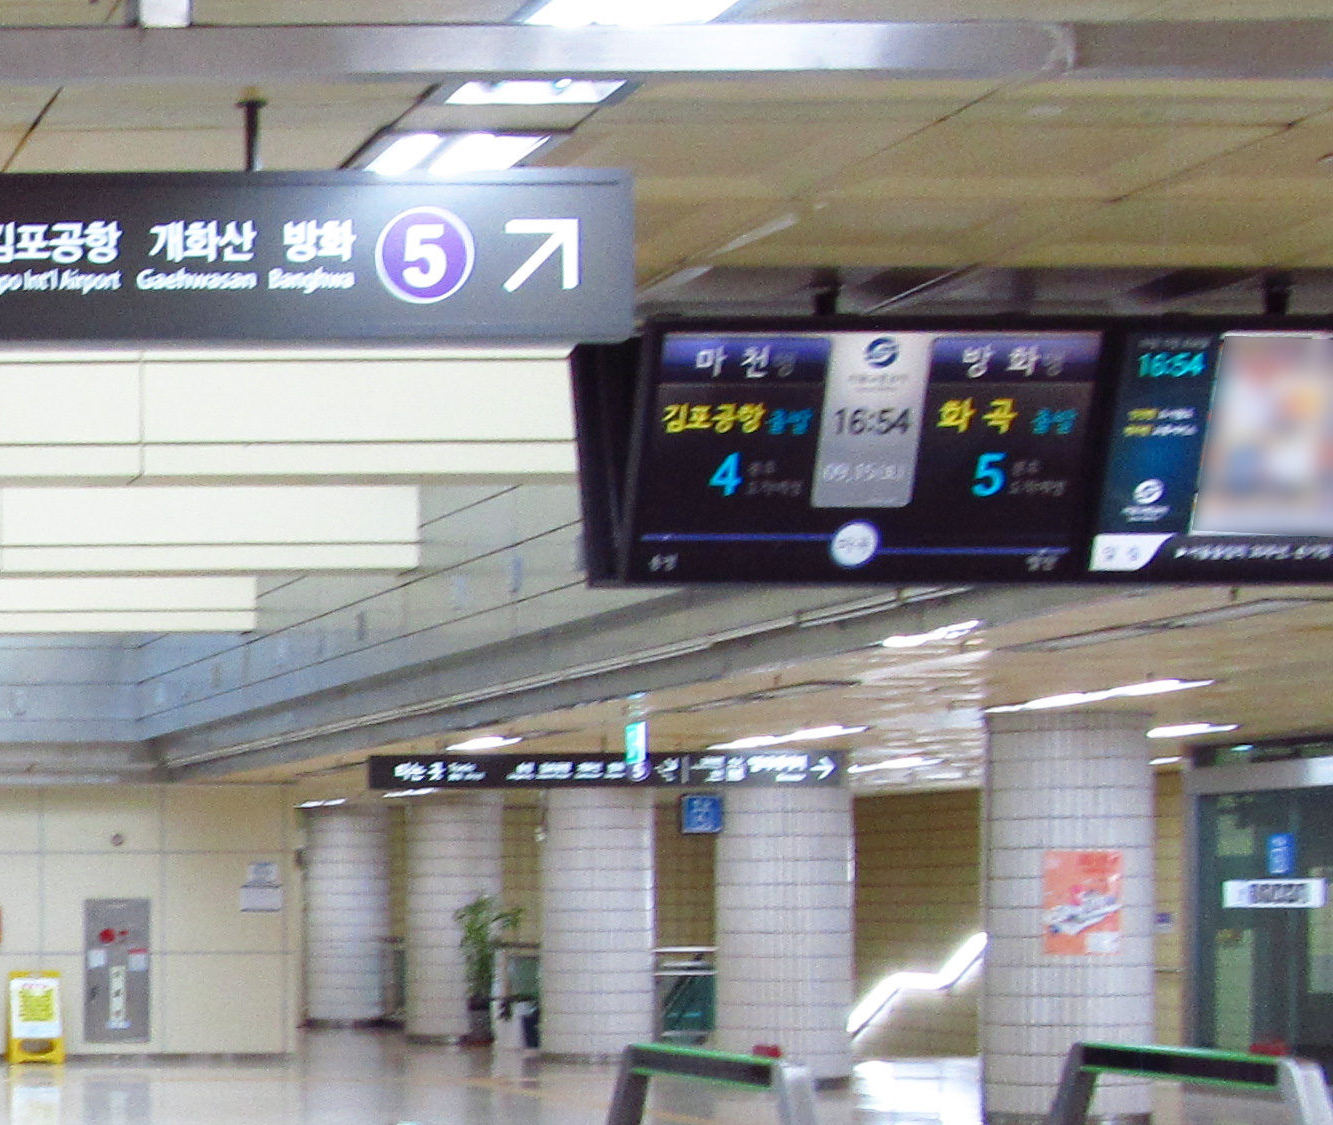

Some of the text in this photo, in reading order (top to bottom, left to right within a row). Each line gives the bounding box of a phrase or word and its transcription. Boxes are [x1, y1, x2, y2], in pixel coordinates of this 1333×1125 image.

[147, 218, 258, 264] 개화산
[282, 218, 357, 264] 방화
[402, 223, 447, 289] 5
[135, 266, 259, 291] Gaehwasan
[266, 266, 357, 294] Banghwa
[661, 401, 768, 435] 김포공항
[832, 406, 913, 436] 16:54
[708, 451, 745, 497] 4
[969, 451, 1009, 497] 5
